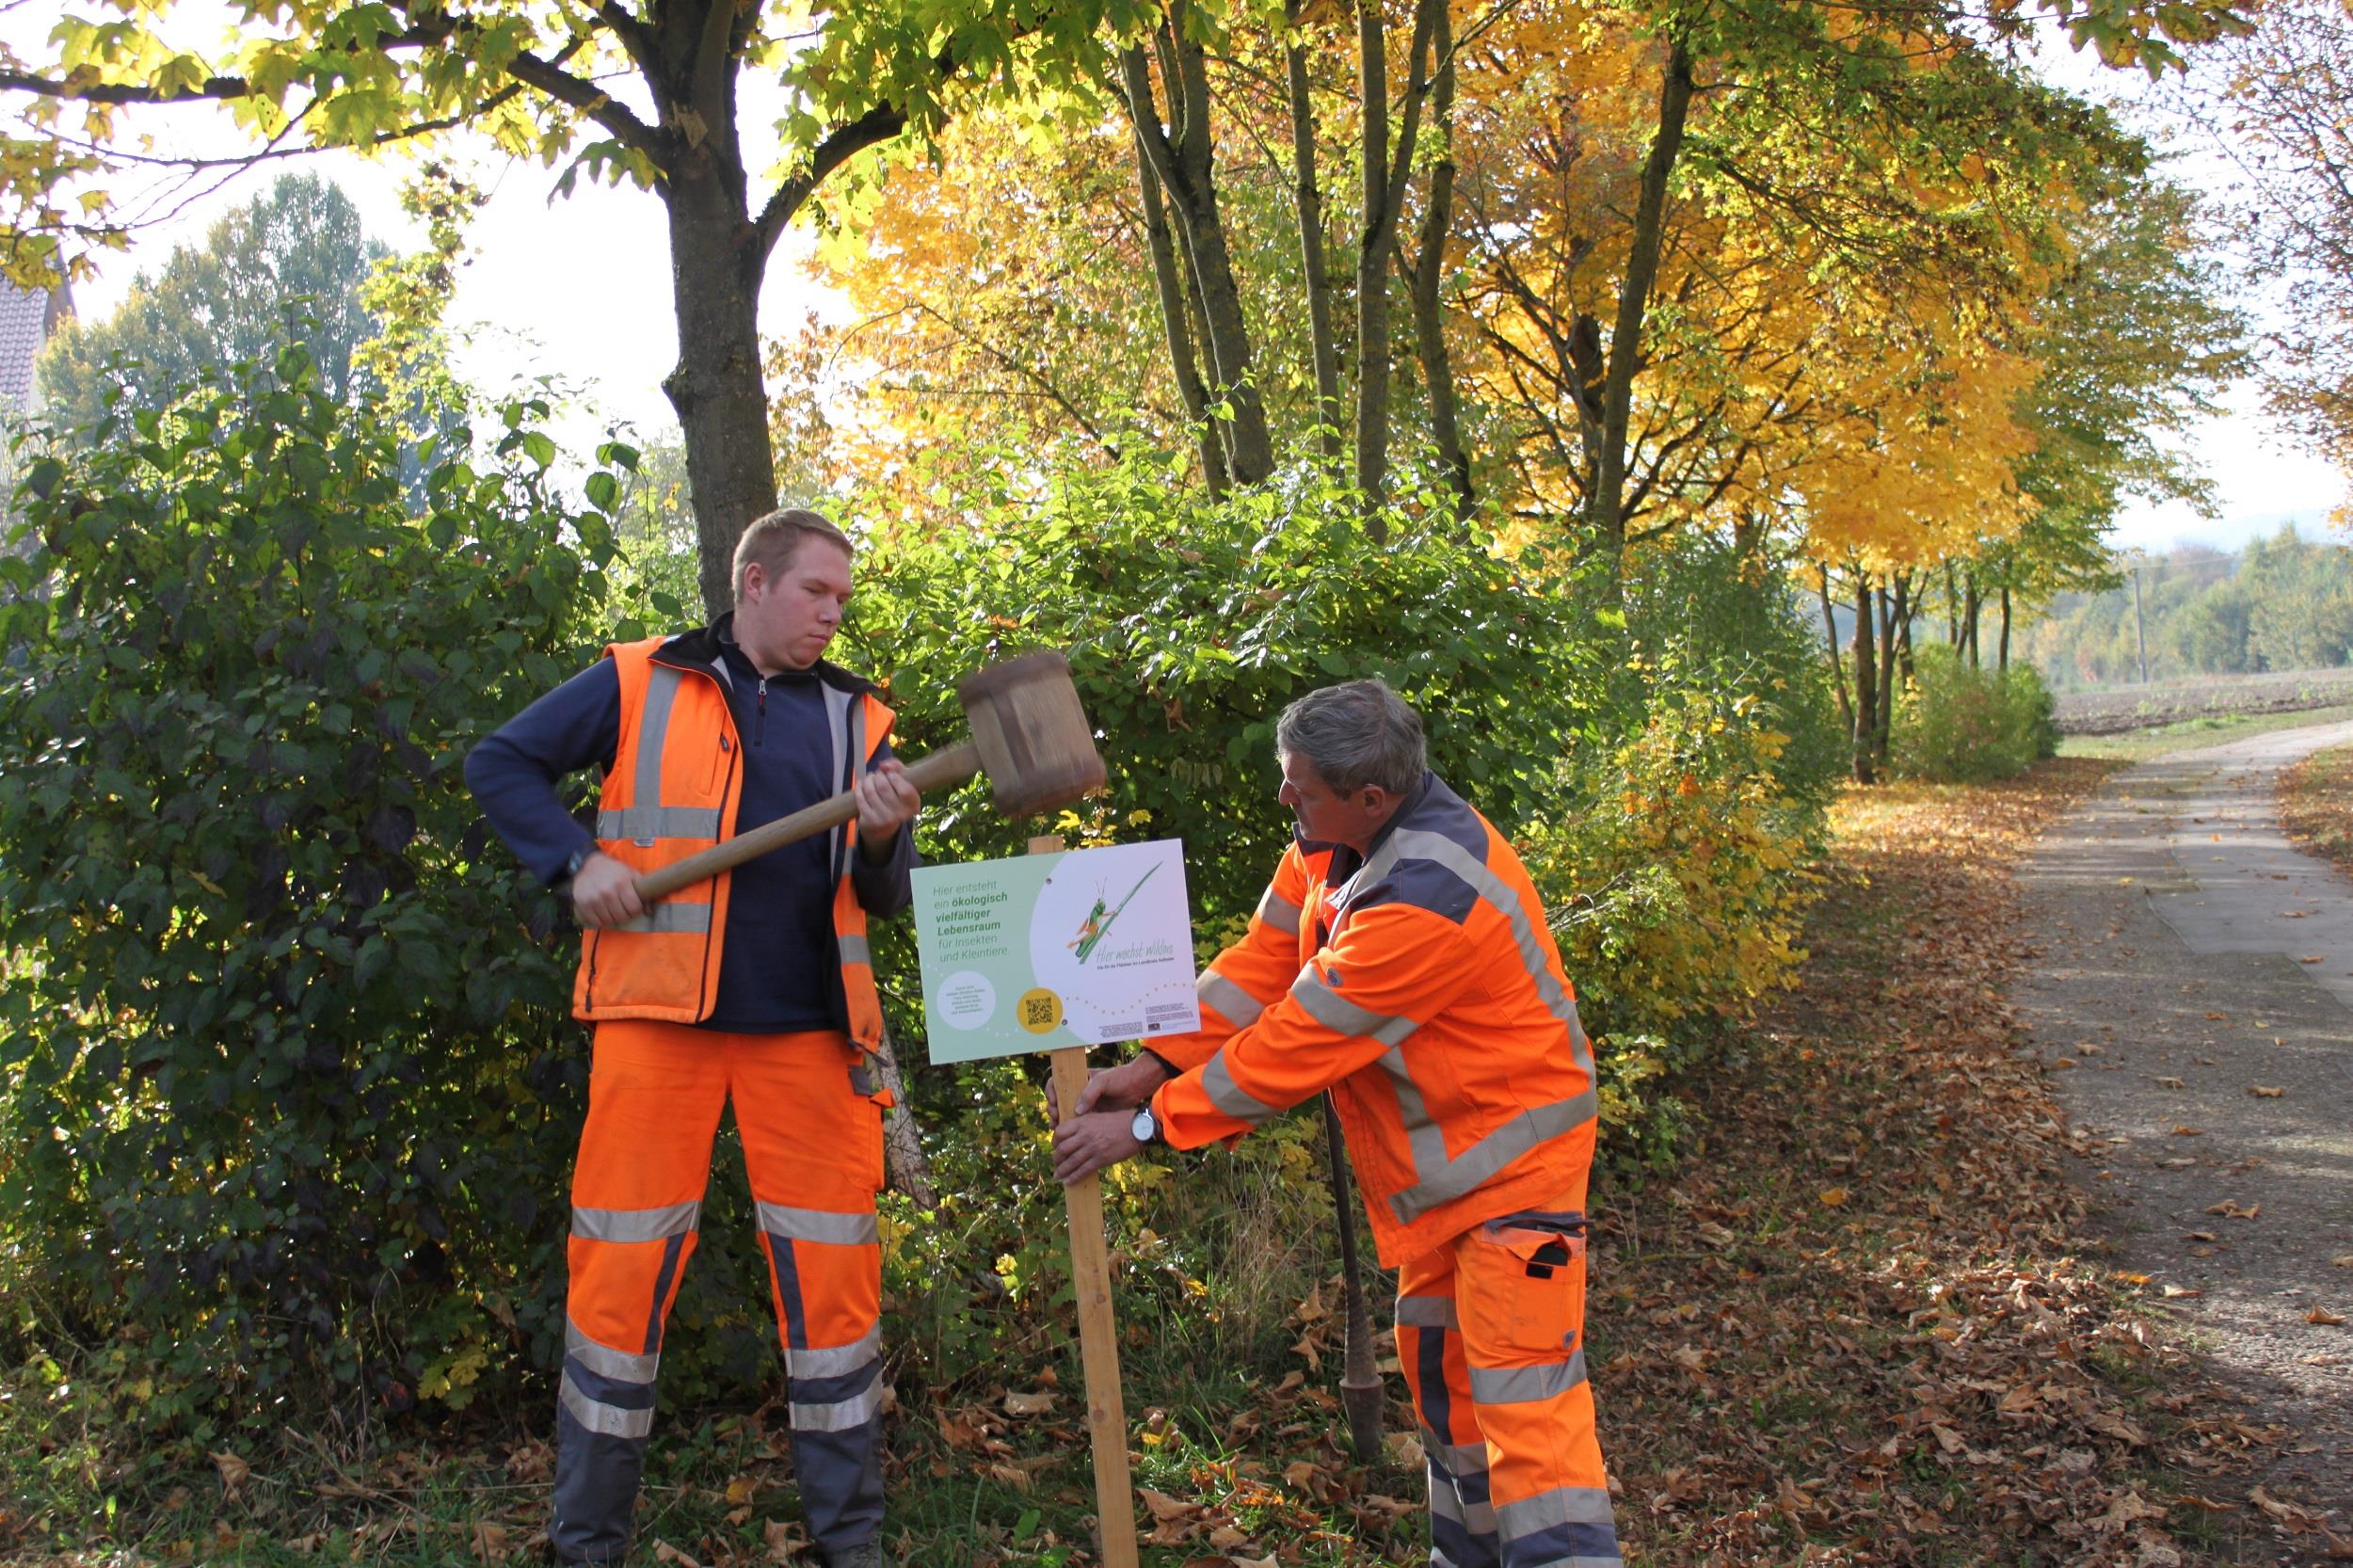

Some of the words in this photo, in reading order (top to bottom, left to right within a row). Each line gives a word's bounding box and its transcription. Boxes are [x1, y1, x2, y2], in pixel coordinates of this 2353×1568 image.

[933, 885, 952, 896] Hier
[955, 881, 997, 893] entsteht
[934, 900, 949, 909] ein
[952, 892, 1008, 906] ökologisch
[936, 909, 990, 923] vielfältiger
[937, 921, 1001, 936] Lebensraum
[938, 938, 952, 949] für
[955, 935, 997, 947] Insekten
[939, 951, 958, 962] und
